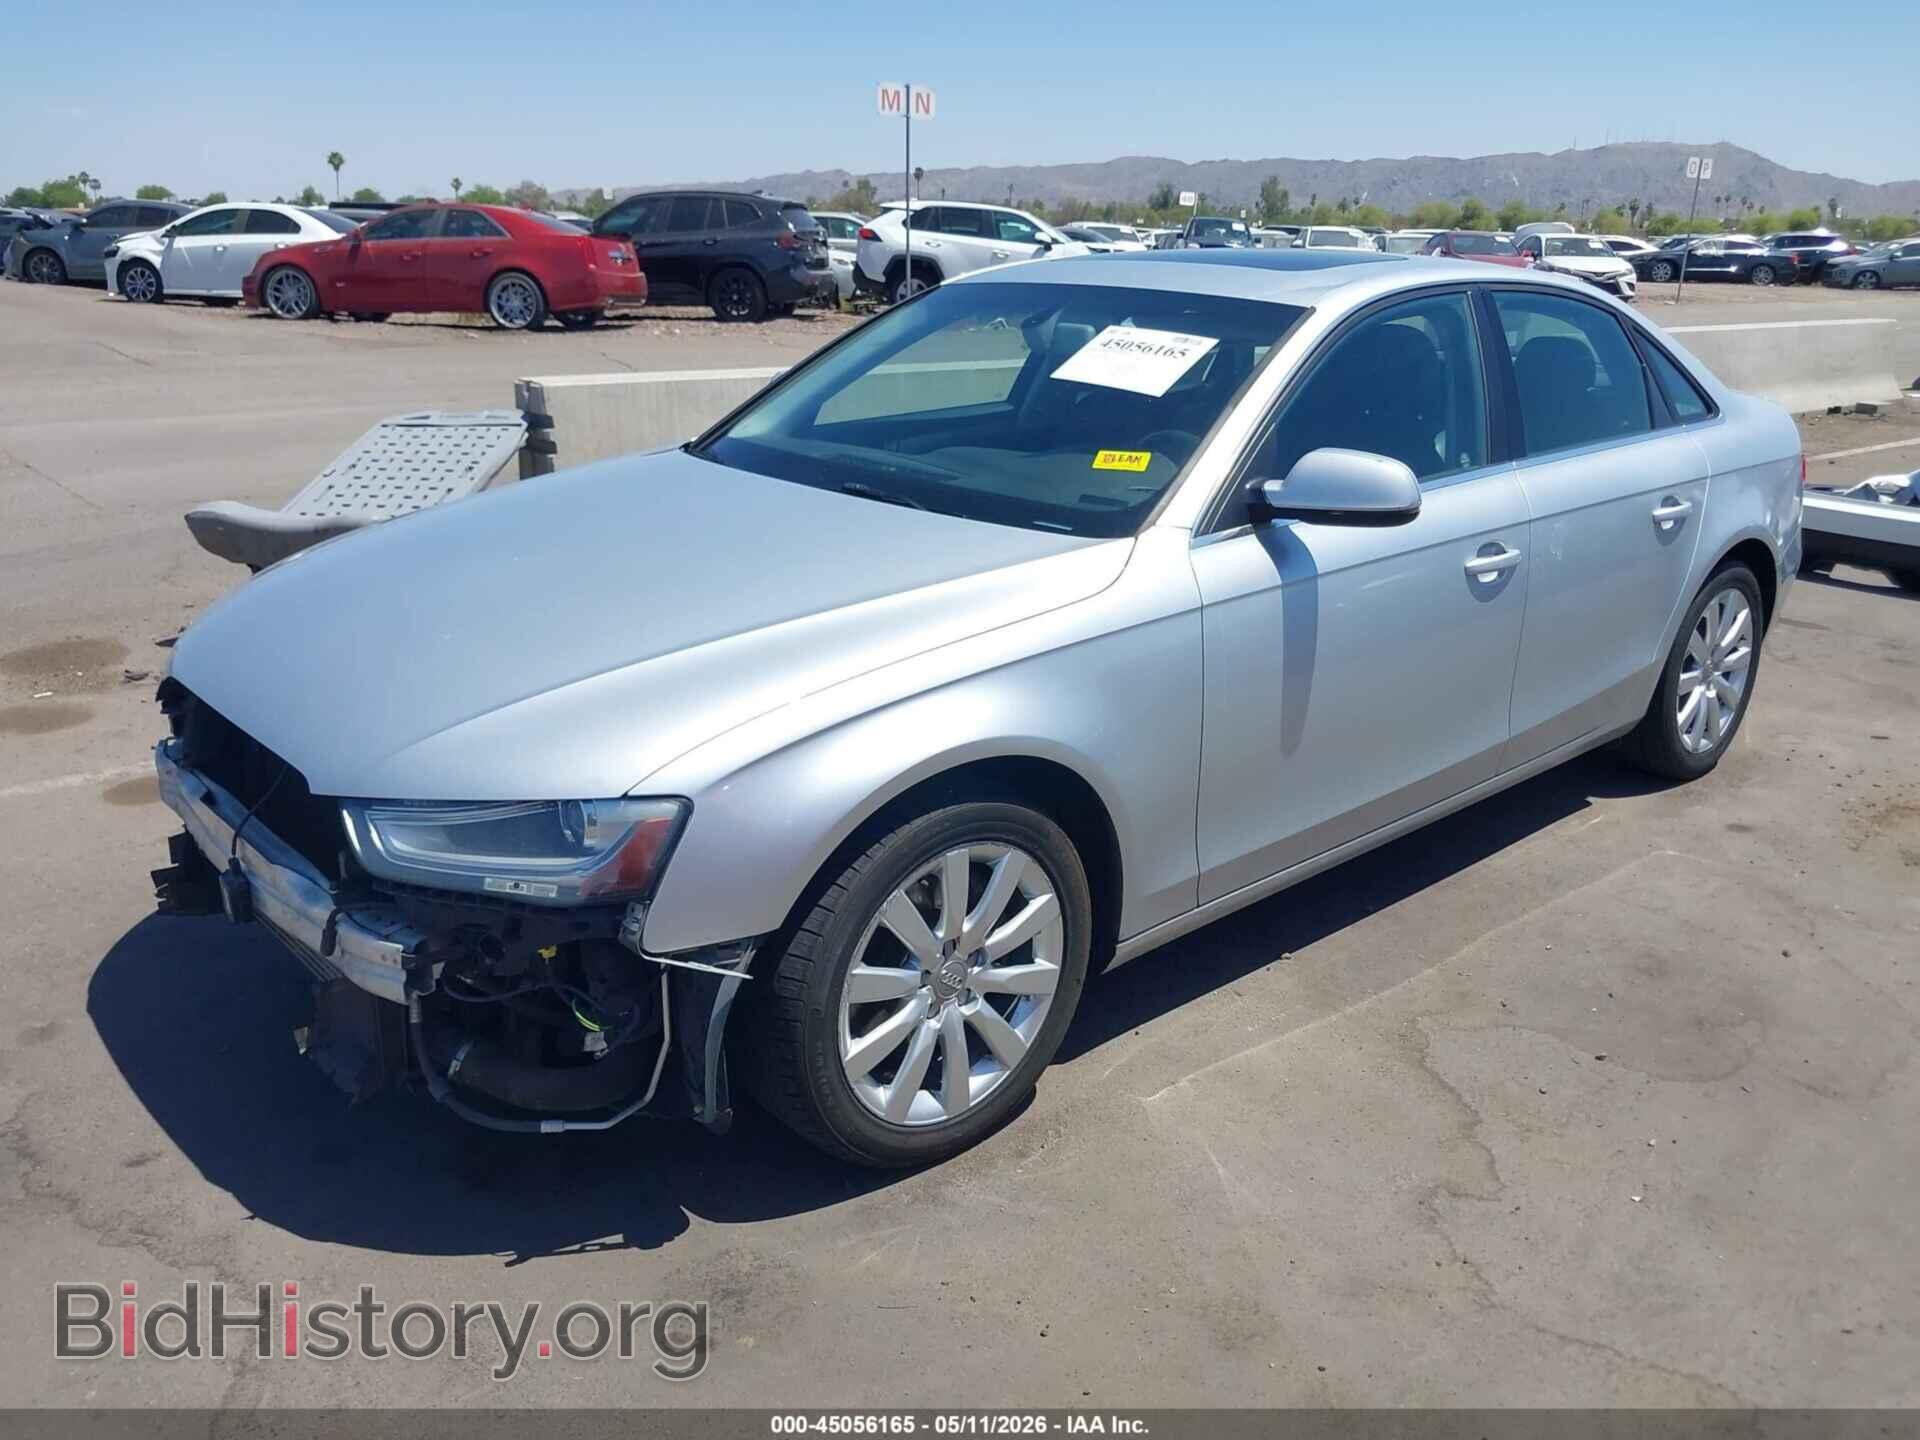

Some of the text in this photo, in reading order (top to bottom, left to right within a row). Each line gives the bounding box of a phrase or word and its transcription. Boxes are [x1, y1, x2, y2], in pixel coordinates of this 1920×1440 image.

[881, 88, 901, 112] M
[915, 92, 931, 114] N
[1099, 337, 1191, 360] 45056165
